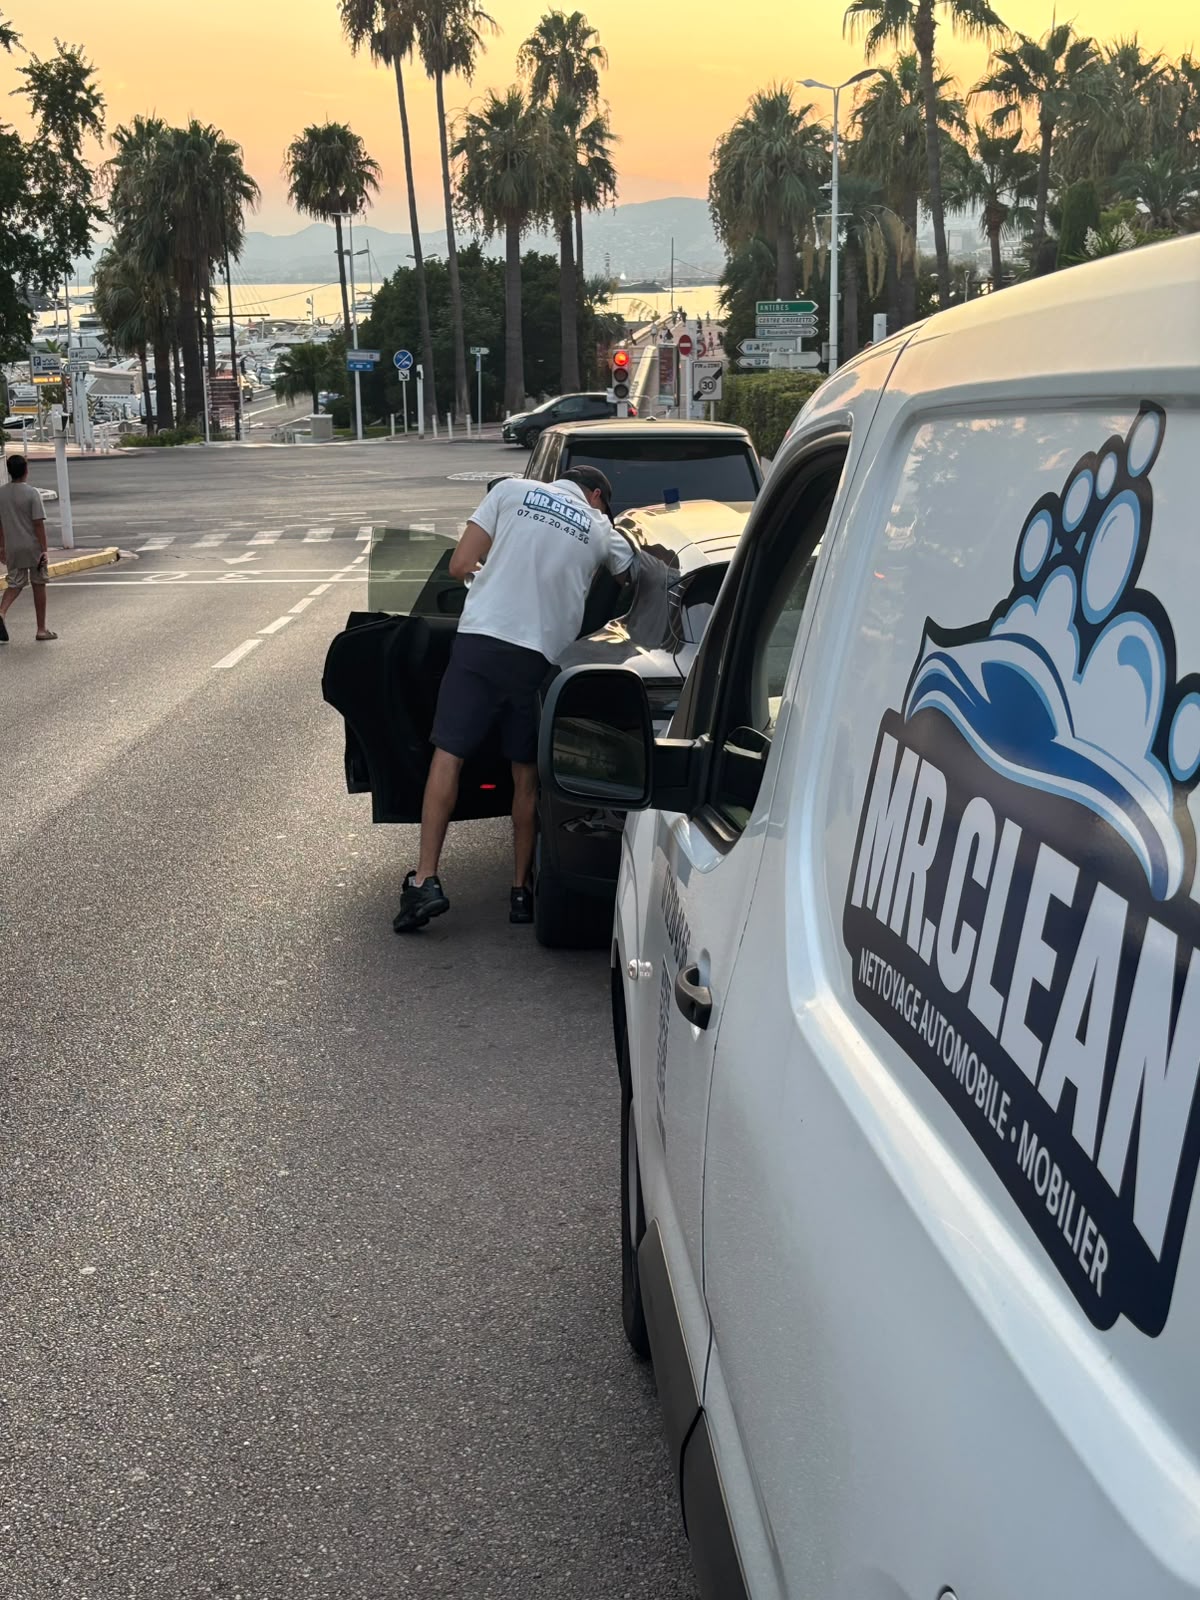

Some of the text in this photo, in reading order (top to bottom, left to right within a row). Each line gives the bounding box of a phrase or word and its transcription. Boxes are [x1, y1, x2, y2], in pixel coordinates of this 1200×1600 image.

[702, 381, 714, 390] 30
[525, 491, 592, 530] MR.CLEAN
[859, 946, 1110, 1298] NETTOYAGE AUTOMOBILE MOBILIER
